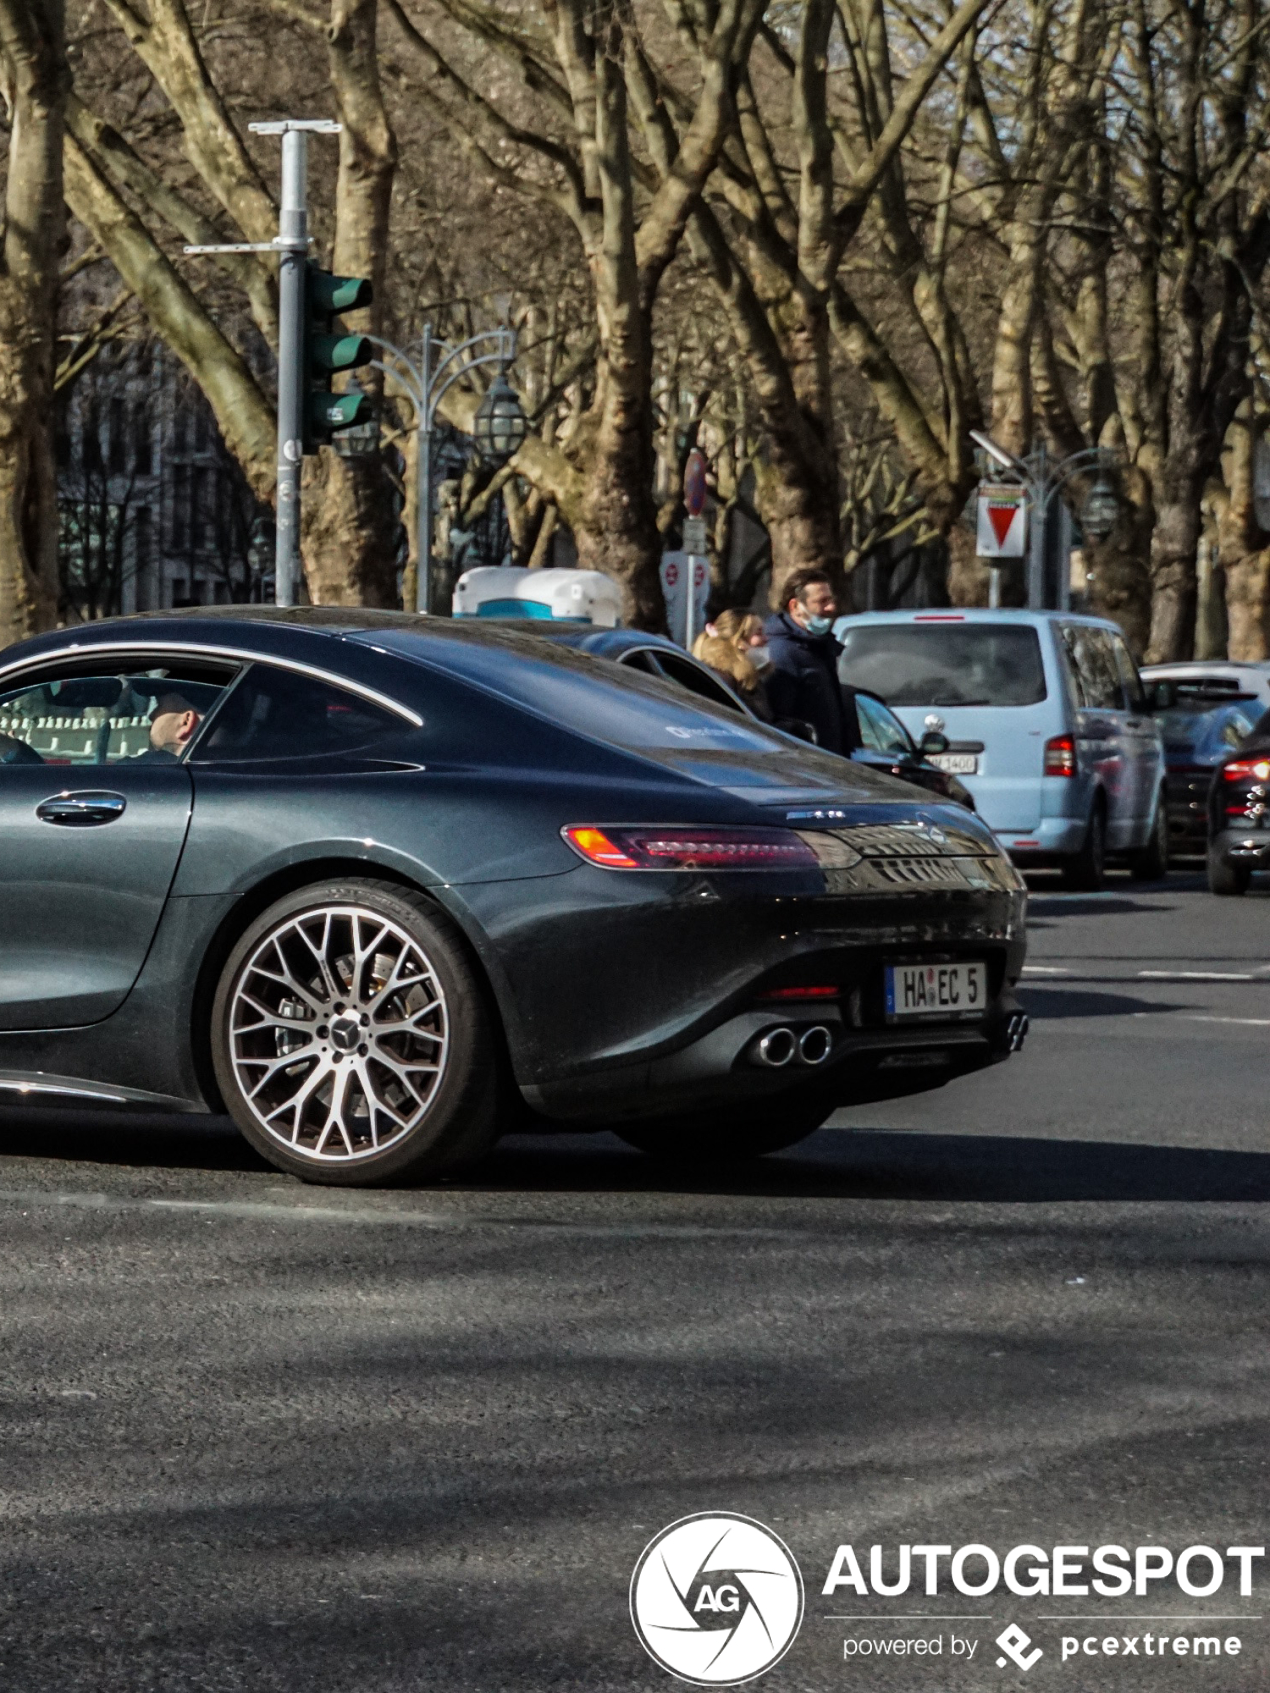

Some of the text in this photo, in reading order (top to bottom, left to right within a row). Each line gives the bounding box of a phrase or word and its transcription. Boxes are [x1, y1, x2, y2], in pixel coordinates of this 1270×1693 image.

[904, 967, 978, 1008] HA EC 5
